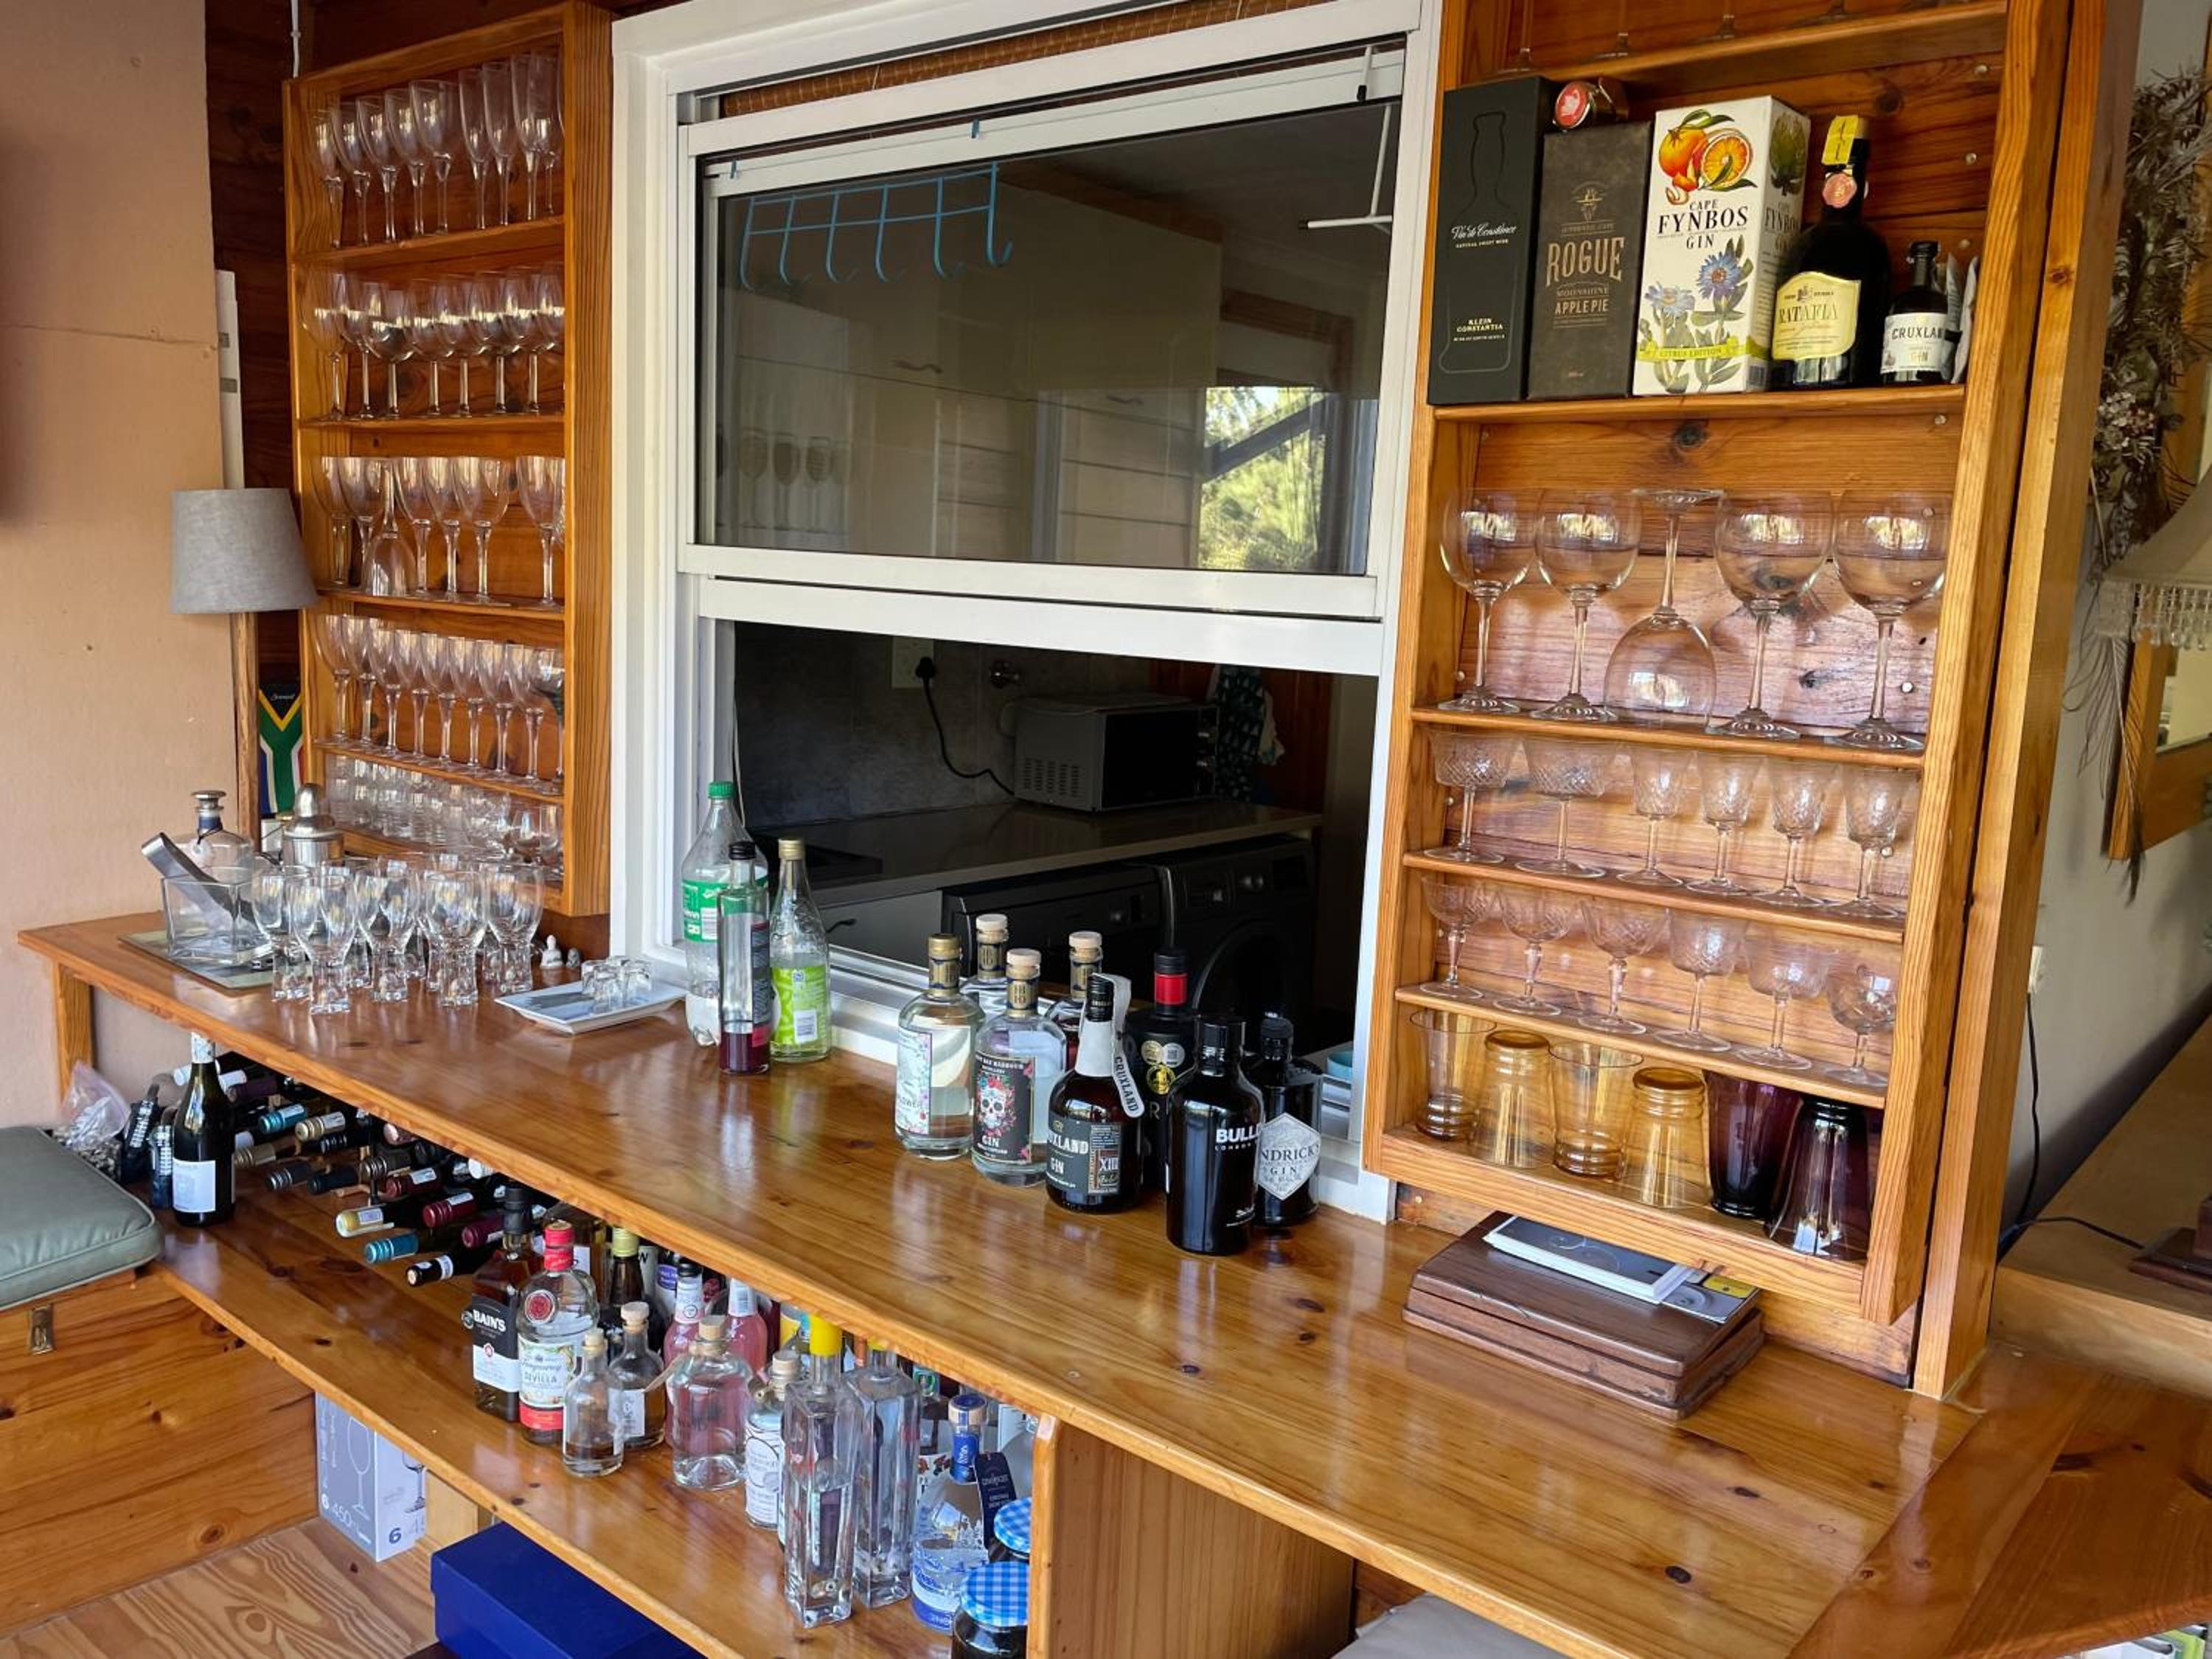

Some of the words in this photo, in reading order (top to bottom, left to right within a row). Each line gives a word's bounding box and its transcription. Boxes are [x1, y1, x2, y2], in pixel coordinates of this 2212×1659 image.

[1689, 199, 1718, 211] CAPE
[1658, 206, 1748, 234] FYNBOS
[1686, 234, 1714, 249] GIN
[1545, 237, 1625, 288] ROGUE
[1555, 300, 1589, 315] APPLE
[1590, 299, 1610, 313] PIE
[1116, 1057, 1140, 1111] CRUXLAND
[982, 1135, 1001, 1148] GIN
[1270, 1166, 1297, 1175] GIN
[473, 1309, 507, 1332] BAIN'S
[389, 1527, 402, 1544] 6
